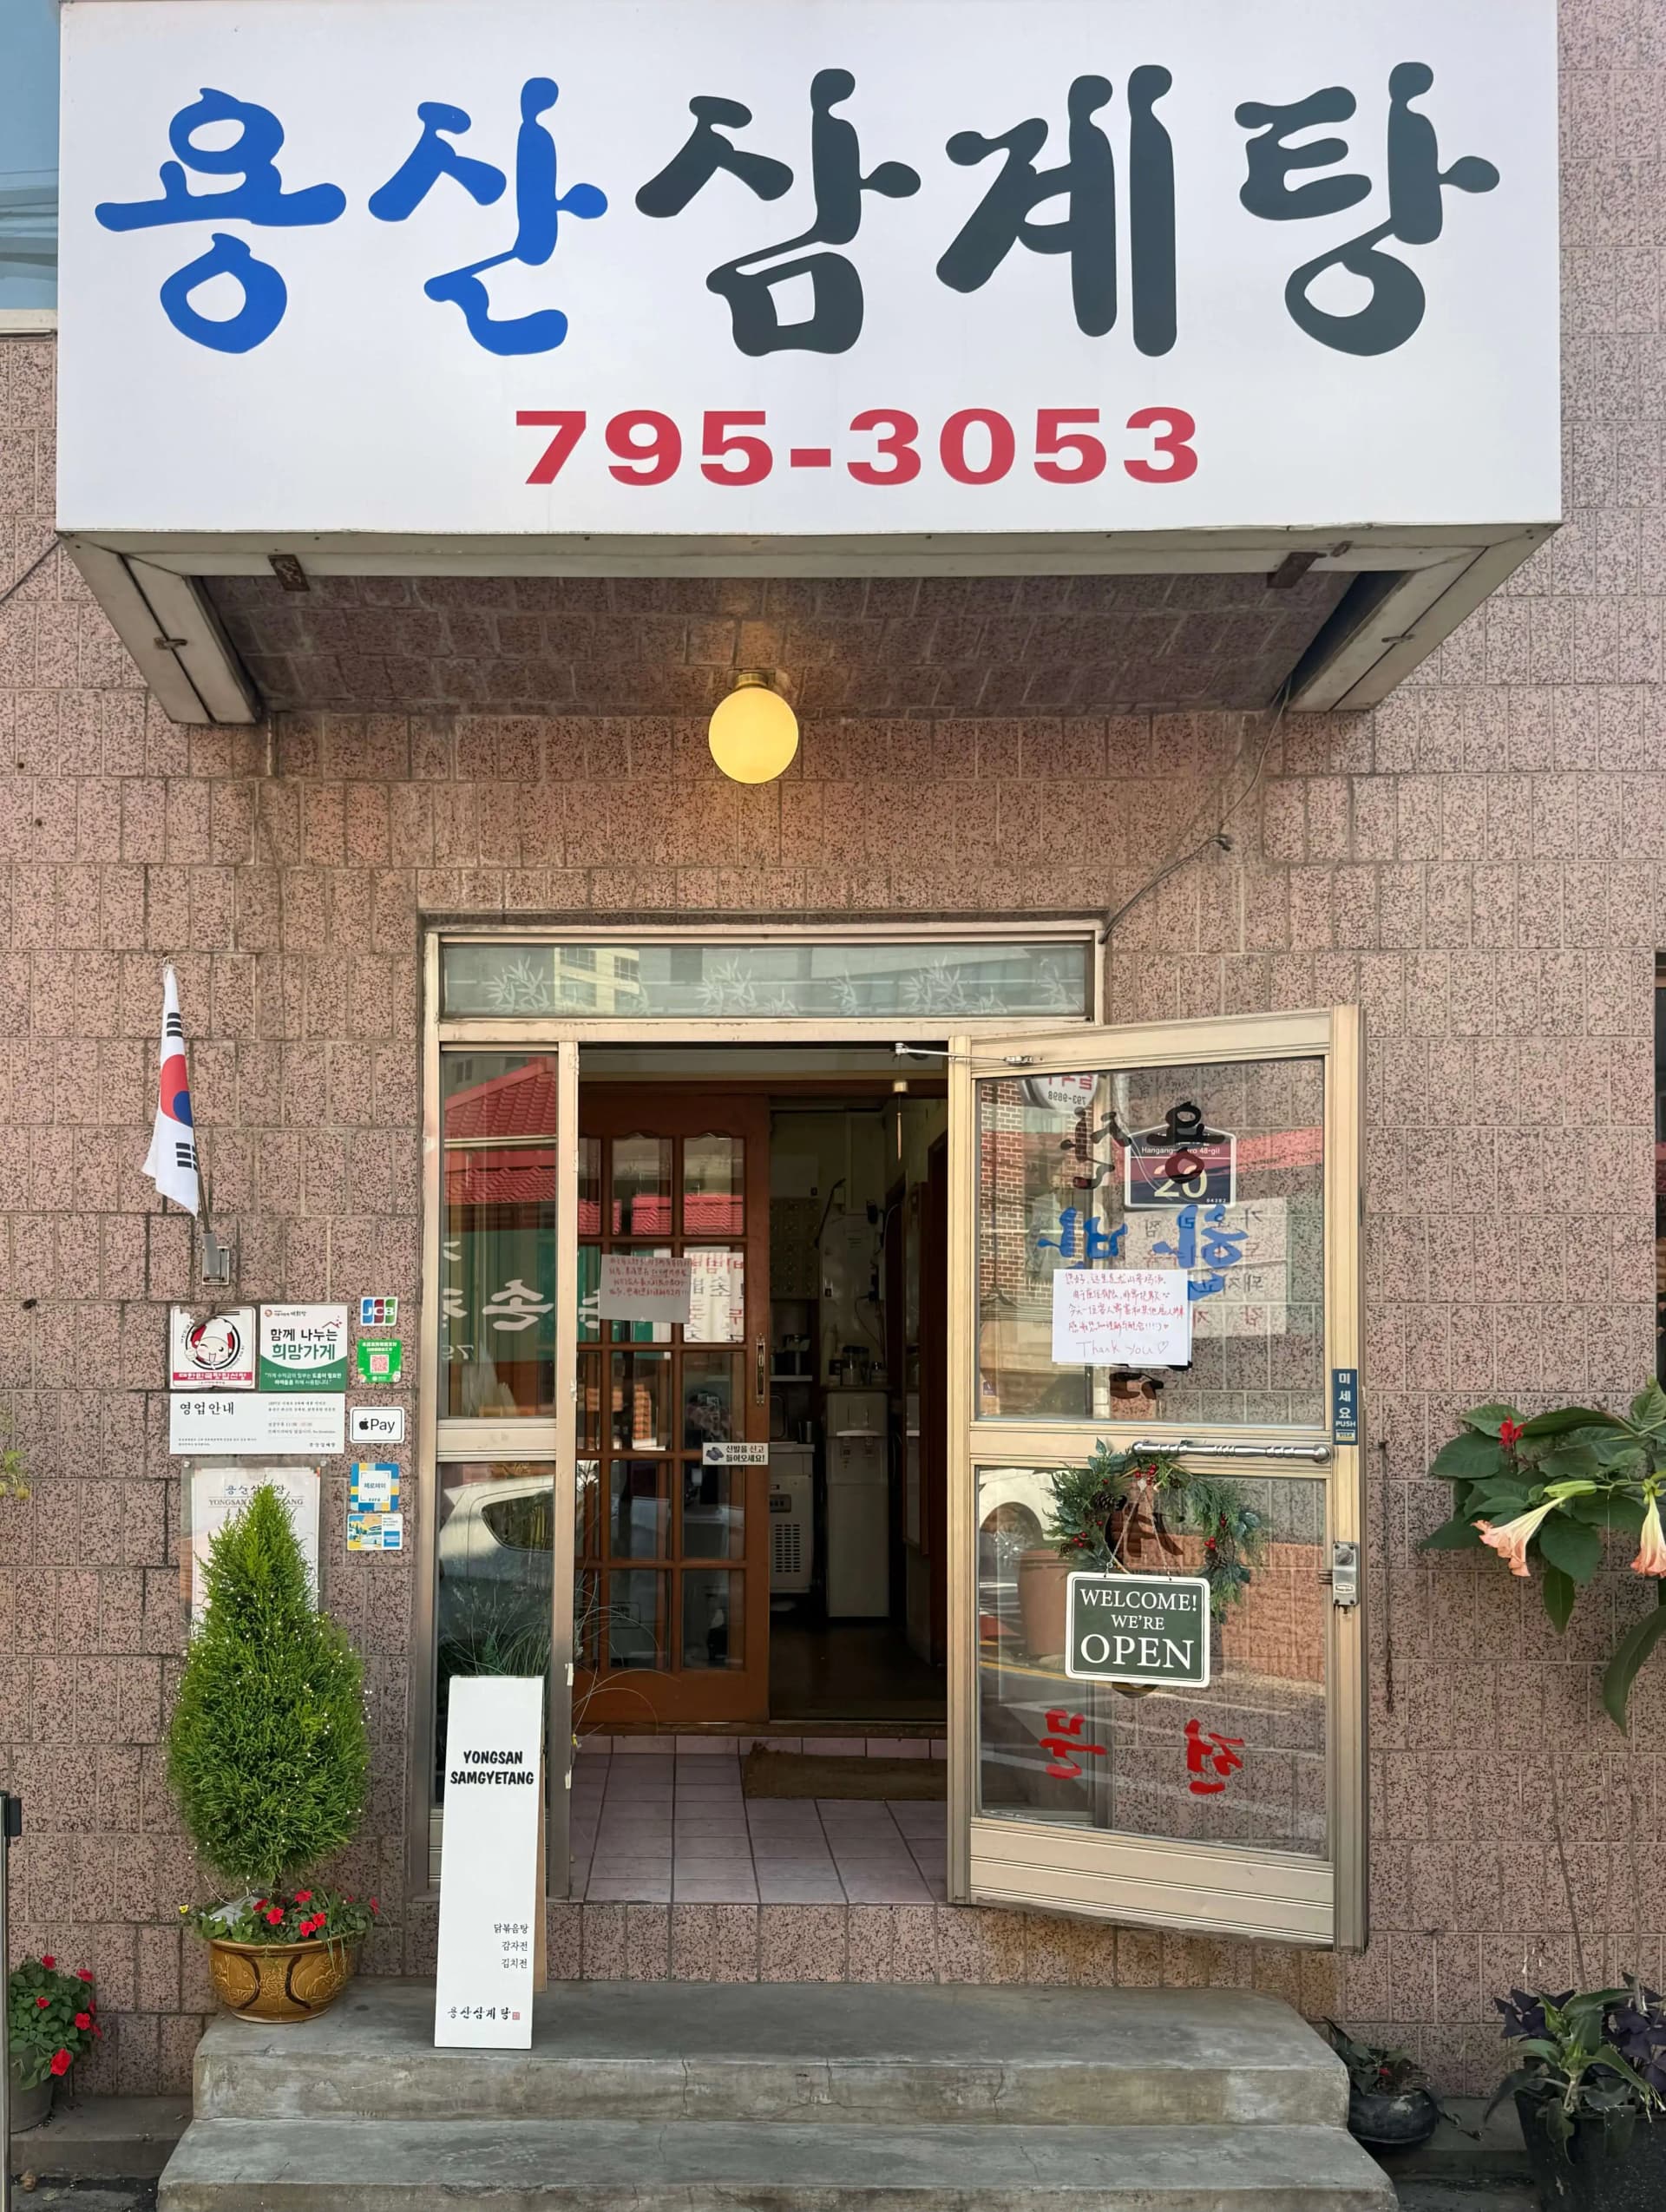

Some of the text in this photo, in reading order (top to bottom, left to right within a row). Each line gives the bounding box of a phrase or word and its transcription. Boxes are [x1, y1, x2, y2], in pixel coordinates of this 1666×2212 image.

[515, 406, 1198, 487] 795-3053
[363, 1306, 395, 1316] JCB
[271, 1329, 338, 1342] 함께 나누는
[272, 1343, 336, 1361] 희망가게
[1075, 1339, 1121, 1358] Thank
[1338, 1373, 1351, 1419] 미세요
[180, 1401, 235, 1416] 영업안내
[371, 1418, 396, 1434] Pay
[725, 1445, 764, 1454] 신발을 신고
[725, 1454, 765, 1463] 들어오세요!
[1080, 1588, 1197, 1611] WELCOME!
[1111, 1614, 1164, 1630] WE'RE
[1080, 1634, 1194, 1670] OPEN
[462, 1749, 523, 1765] YONGSAN
[449, 1770, 535, 1786] SAMGYETANG
[494, 1923, 530, 1934] 닭볶음탕
[502, 1940, 528, 1952] 감자전
[501, 1958, 528, 1969] 김치전
